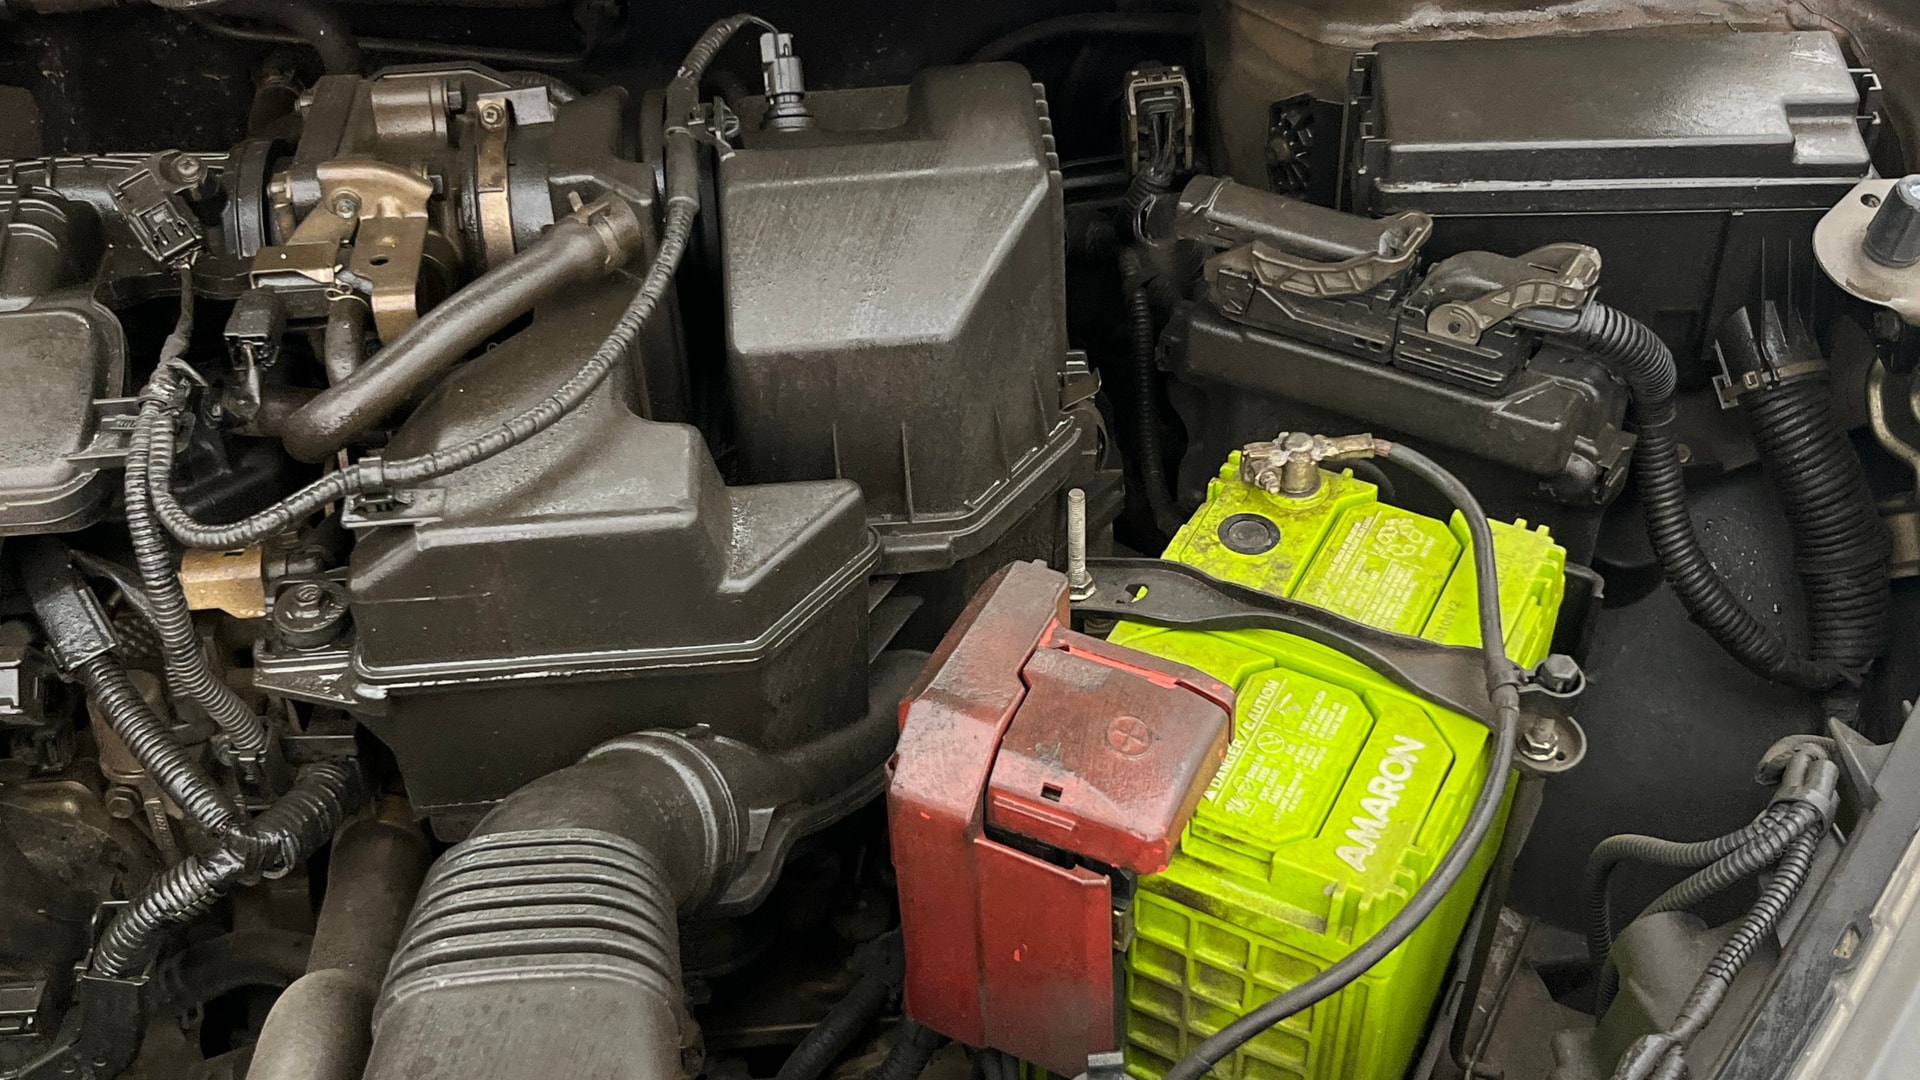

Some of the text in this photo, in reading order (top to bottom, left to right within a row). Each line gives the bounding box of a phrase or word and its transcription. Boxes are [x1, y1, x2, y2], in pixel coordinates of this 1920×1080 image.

[1211, 738, 1244, 788] DANGER
[1242, 679, 1280, 731] CAUTION
[1335, 734, 1426, 872] AMARON
